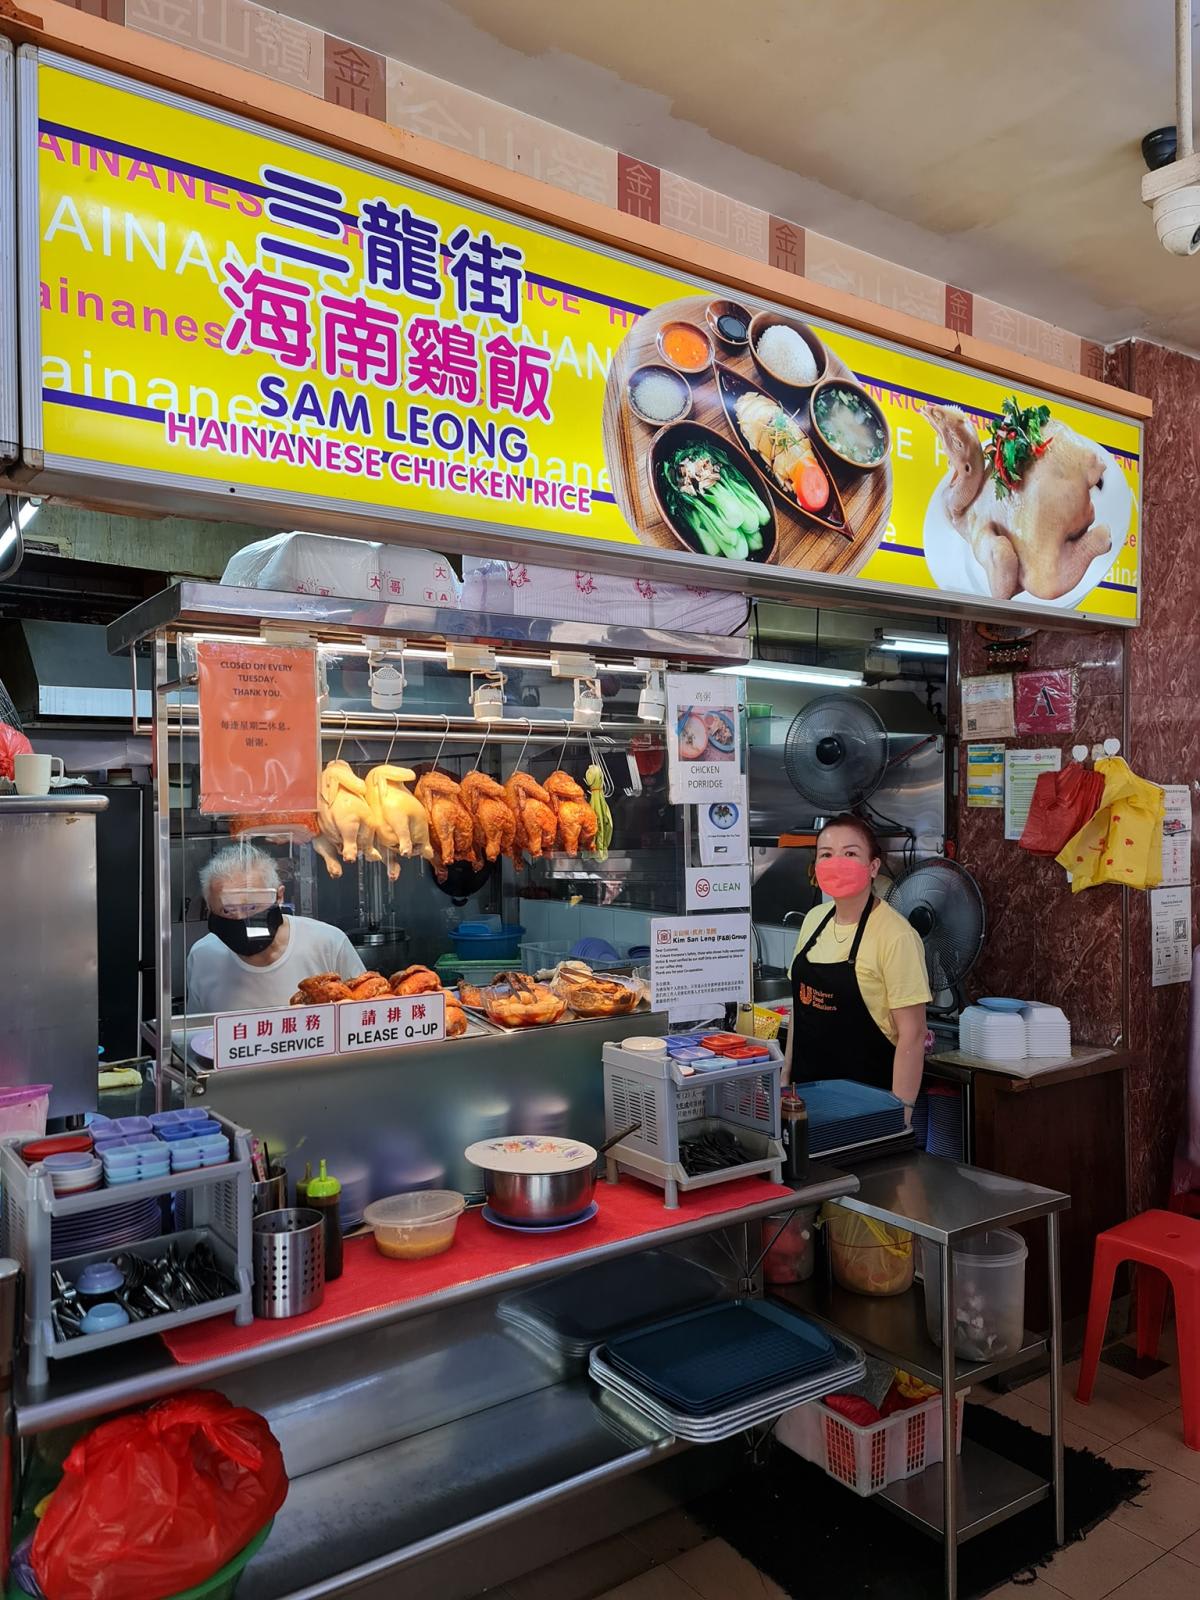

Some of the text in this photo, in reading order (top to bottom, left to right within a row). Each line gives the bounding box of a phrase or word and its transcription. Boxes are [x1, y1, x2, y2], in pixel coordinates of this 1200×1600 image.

[259, 168, 523, 324] 三龍街
[260, 375, 528, 463] SAM LEONG
[167, 411, 590, 514] HAINANESE CHICKEN RICE
[220, 661, 293, 671] CLOSED ON EVERY
[238, 674, 278, 683] TUESDAY.
[232, 688, 261, 696] THANK
[690, 765, 720, 774] CHICKEN
[687, 780, 724, 789] PORRIDGE
[697, 882, 741, 892] SG CLEAN
[687, 935, 698, 943] San
[361, 1004, 426, 1026] 請排隊
[233, 1014, 321, 1040] 自助服務
[347, 1022, 438, 1046] PLEASE Q-UP
[229, 1036, 325, 1060] SELF-SERVICE
